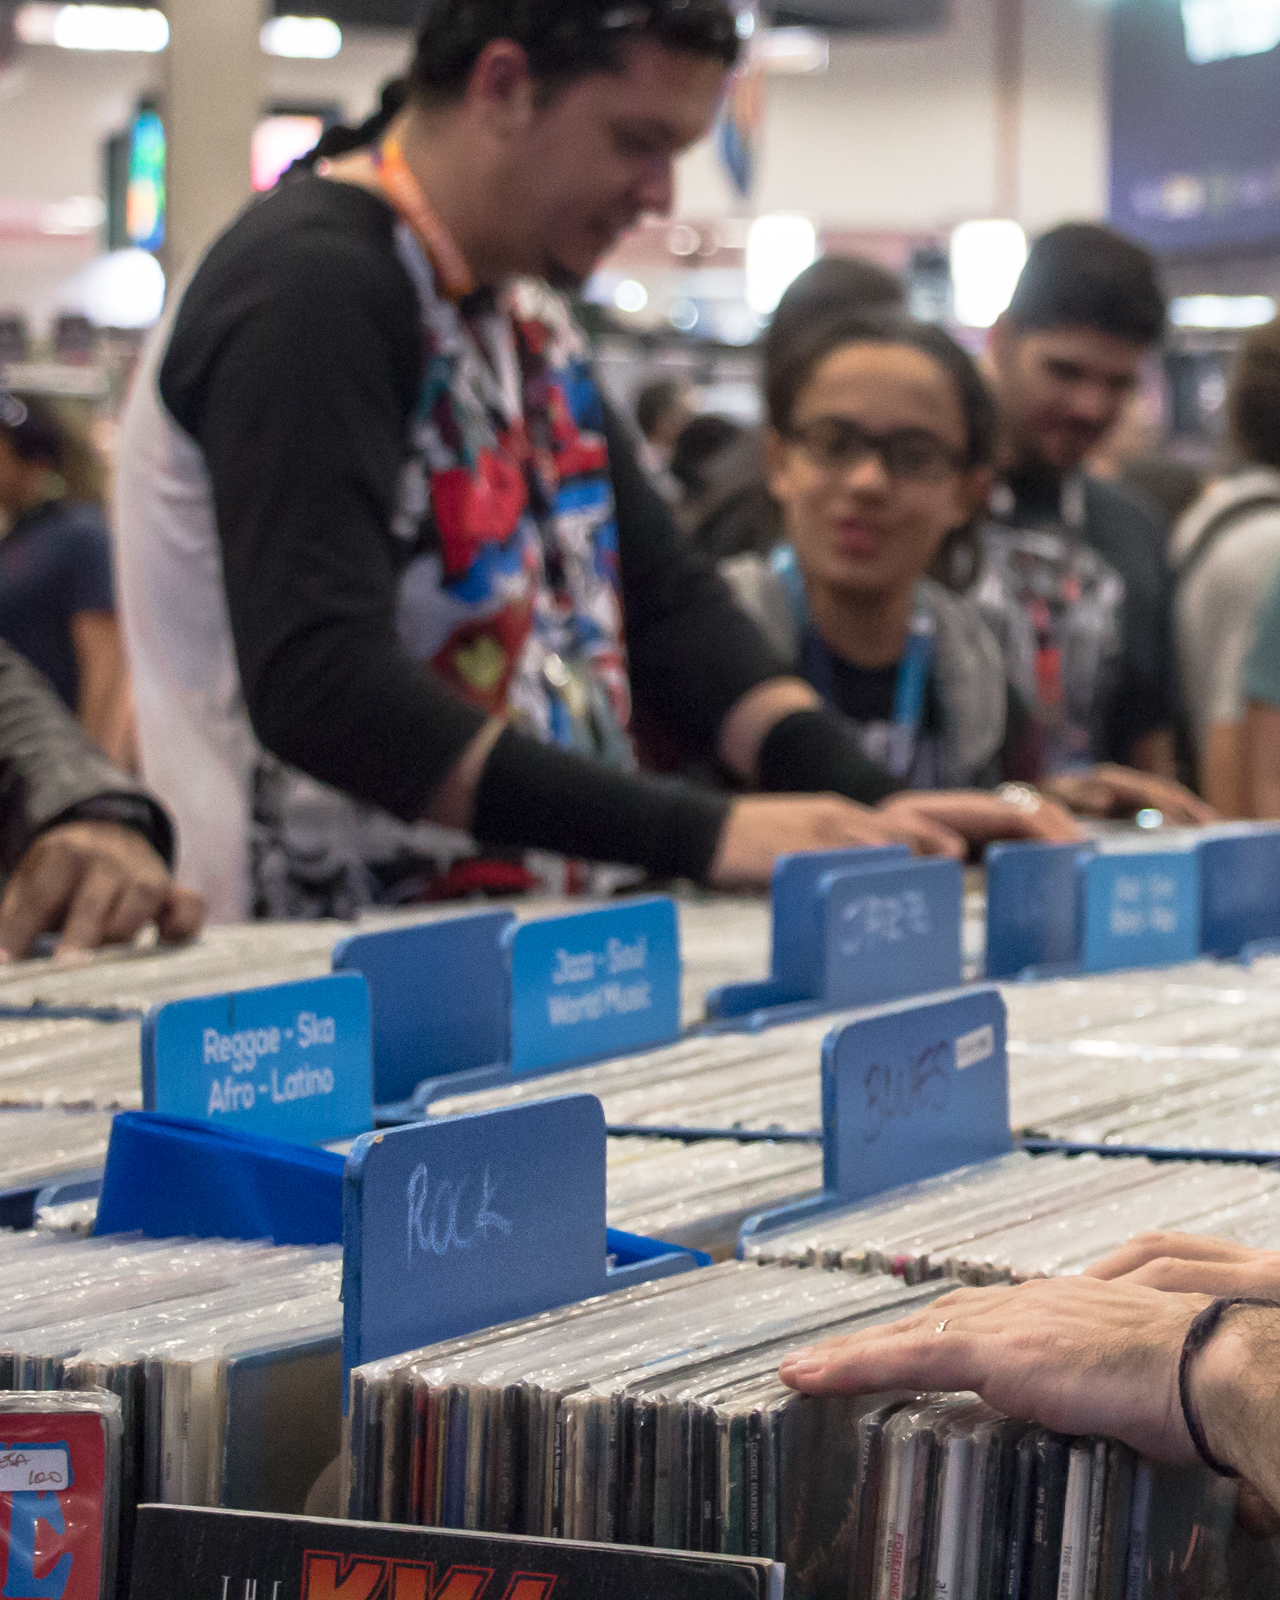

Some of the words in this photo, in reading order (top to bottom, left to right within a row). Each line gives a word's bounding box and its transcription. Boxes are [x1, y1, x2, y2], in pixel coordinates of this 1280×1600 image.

[202, 1026, 281, 1074] Reggae
[297, 1010, 336, 1049] Ska
[207, 1076, 255, 1117] Afro
[271, 1063, 335, 1104] Latino
[29, 1470, 63, 1486] 100
[750, 1442, 759, 1480] GEORGE
[750, 1482, 758, 1531] HARRISON
[890, 1533, 905, 1600] FOREIGNE
